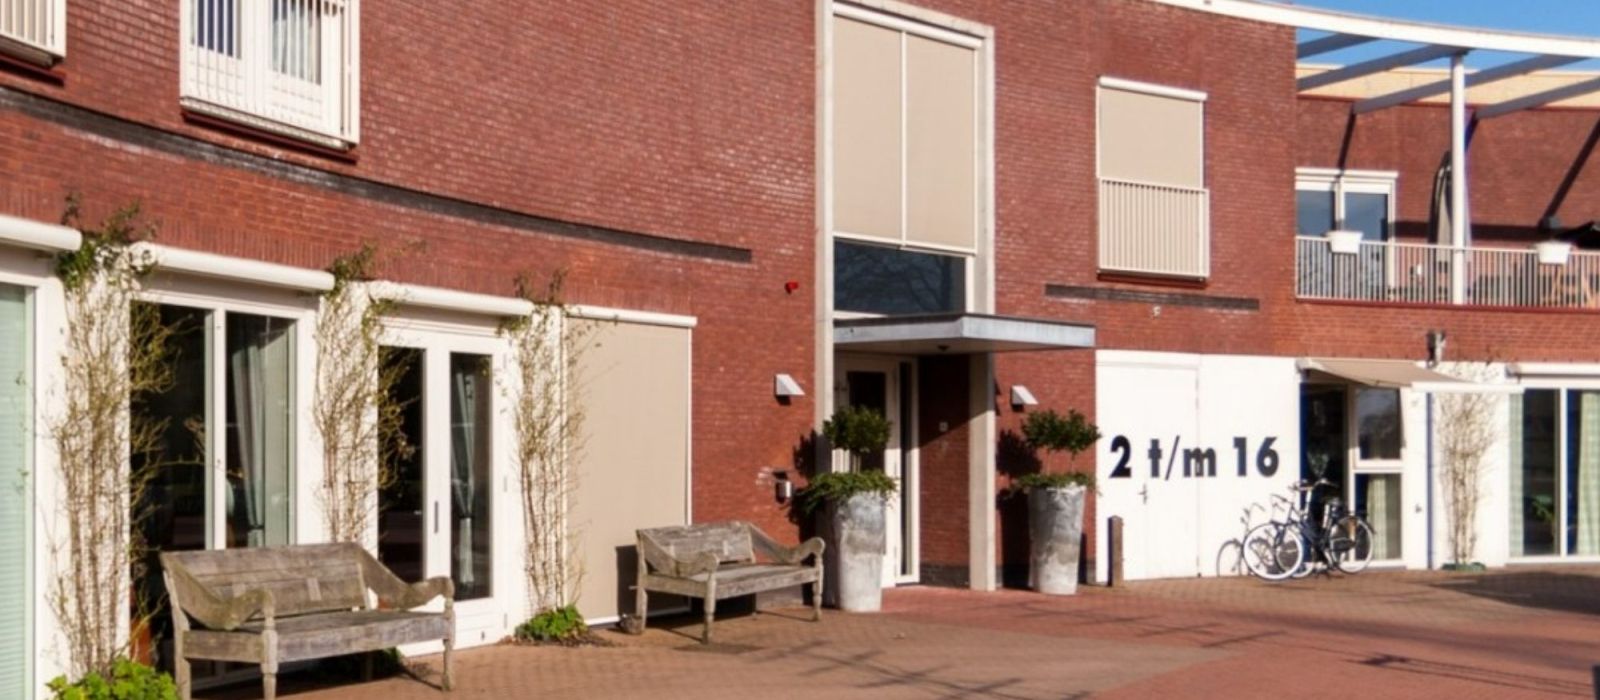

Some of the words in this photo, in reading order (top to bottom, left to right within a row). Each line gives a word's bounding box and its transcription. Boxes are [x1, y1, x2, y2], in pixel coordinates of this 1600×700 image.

[1109, 435, 1132, 478] 2
[1147, 435, 1217, 480] t/m
[1233, 436, 1280, 477] 16
